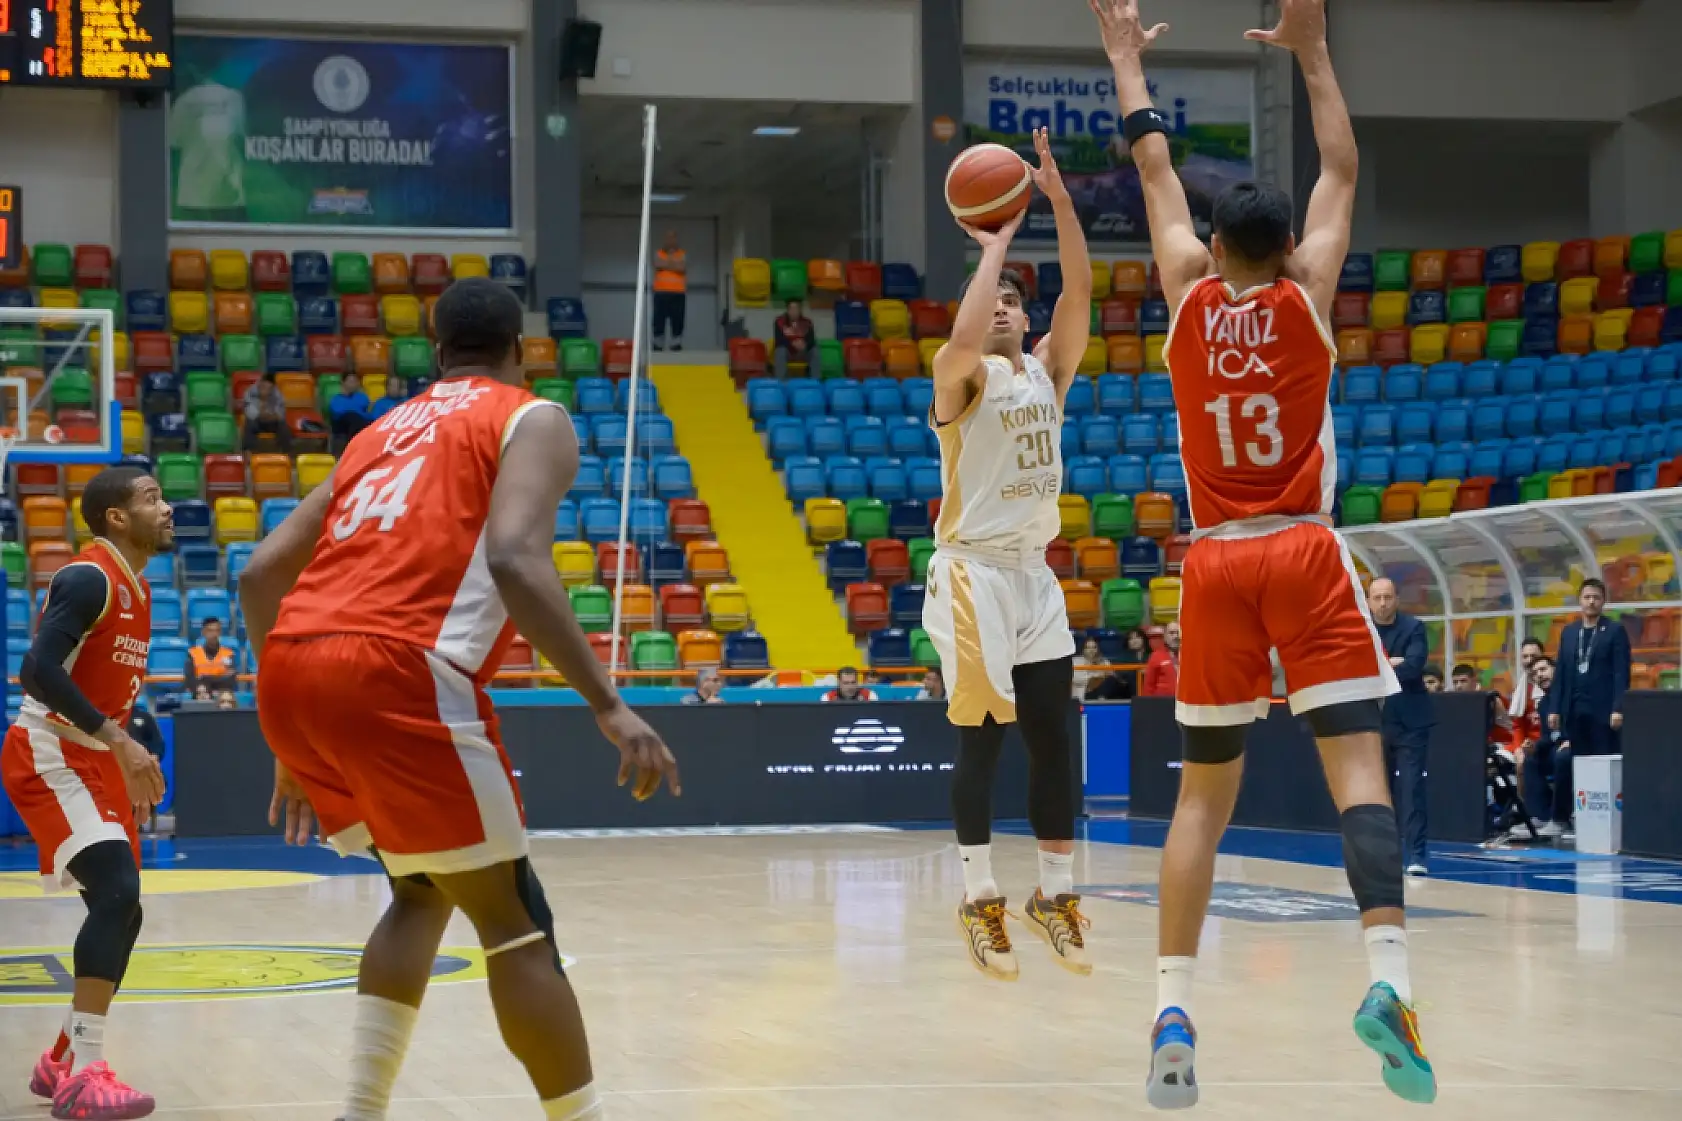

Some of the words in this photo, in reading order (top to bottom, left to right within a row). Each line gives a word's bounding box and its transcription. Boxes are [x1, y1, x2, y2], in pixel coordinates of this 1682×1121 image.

[988, 76, 1088, 98] Selçuklu
[1094, 75, 1159, 104] Çik
[988, 97, 1187, 147] Bahçi
[245, 136, 345, 164] KOŞANLAR
[999, 403, 1057, 432] KONYA
[1204, 394, 1284, 467] 13
[1015, 429, 1054, 470] 20
[333, 456, 425, 540] 54
